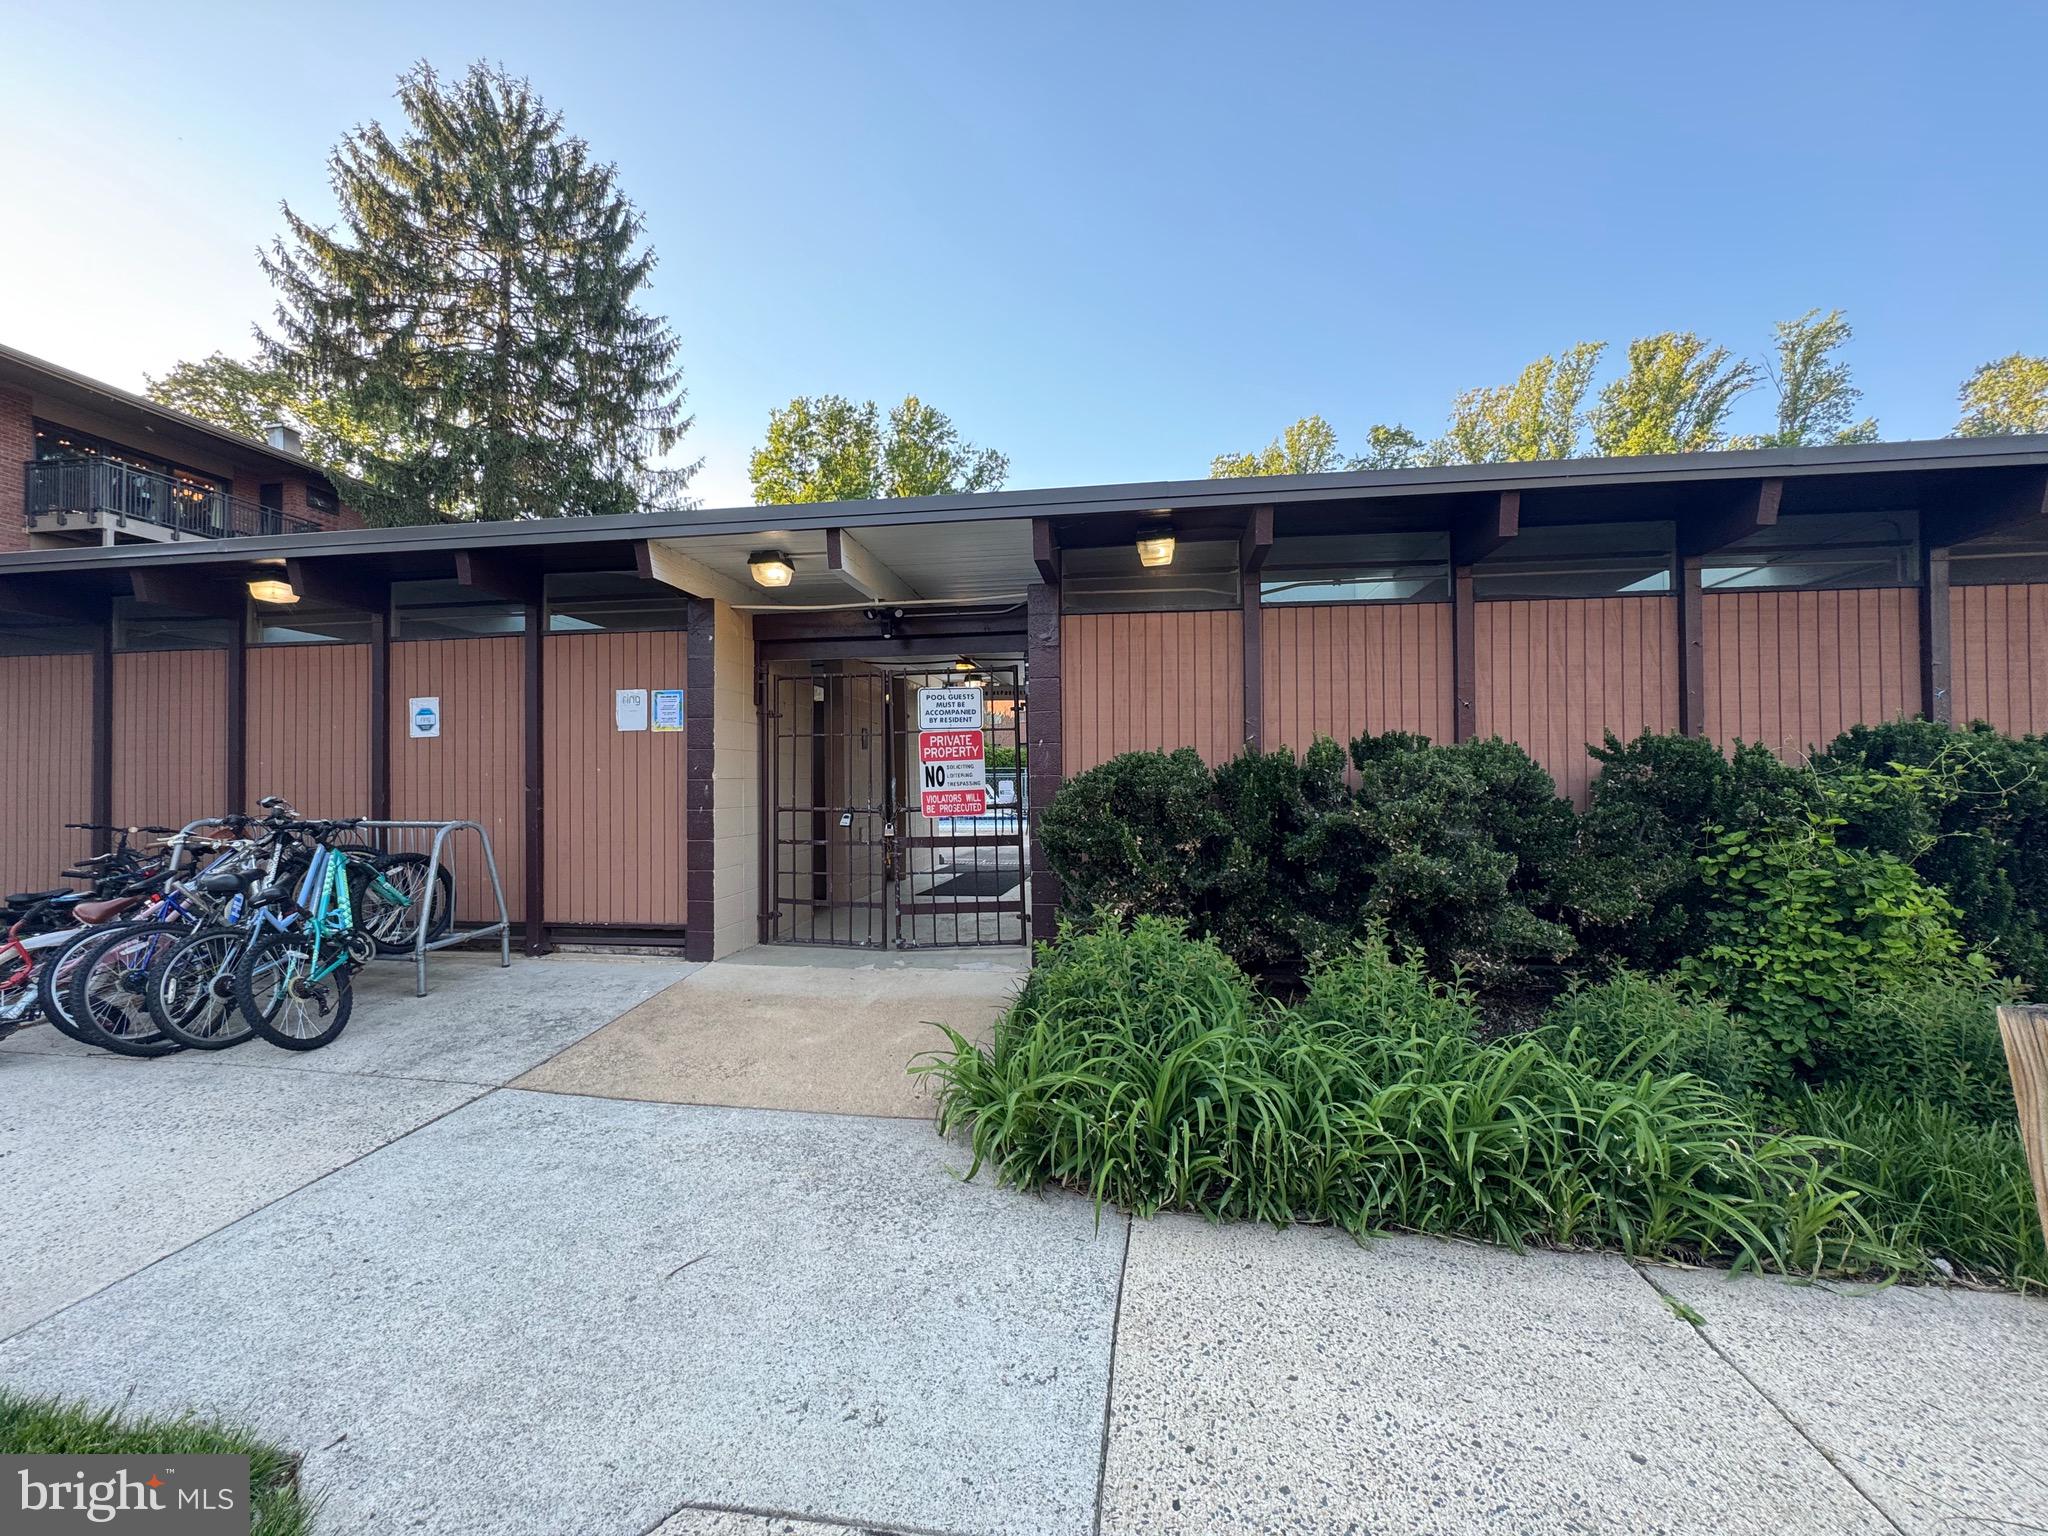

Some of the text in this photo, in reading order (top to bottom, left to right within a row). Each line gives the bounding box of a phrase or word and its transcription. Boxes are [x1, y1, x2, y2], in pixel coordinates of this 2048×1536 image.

[622, 694, 641, 706] ring
[930, 735, 972, 746] PRIVATE
[924, 746, 979, 758] PROPERTY
[925, 765, 945, 788] NO
[926, 794, 981, 804] VIOLATORS WILL
[927, 803, 982, 813] BE PROSECUTED
